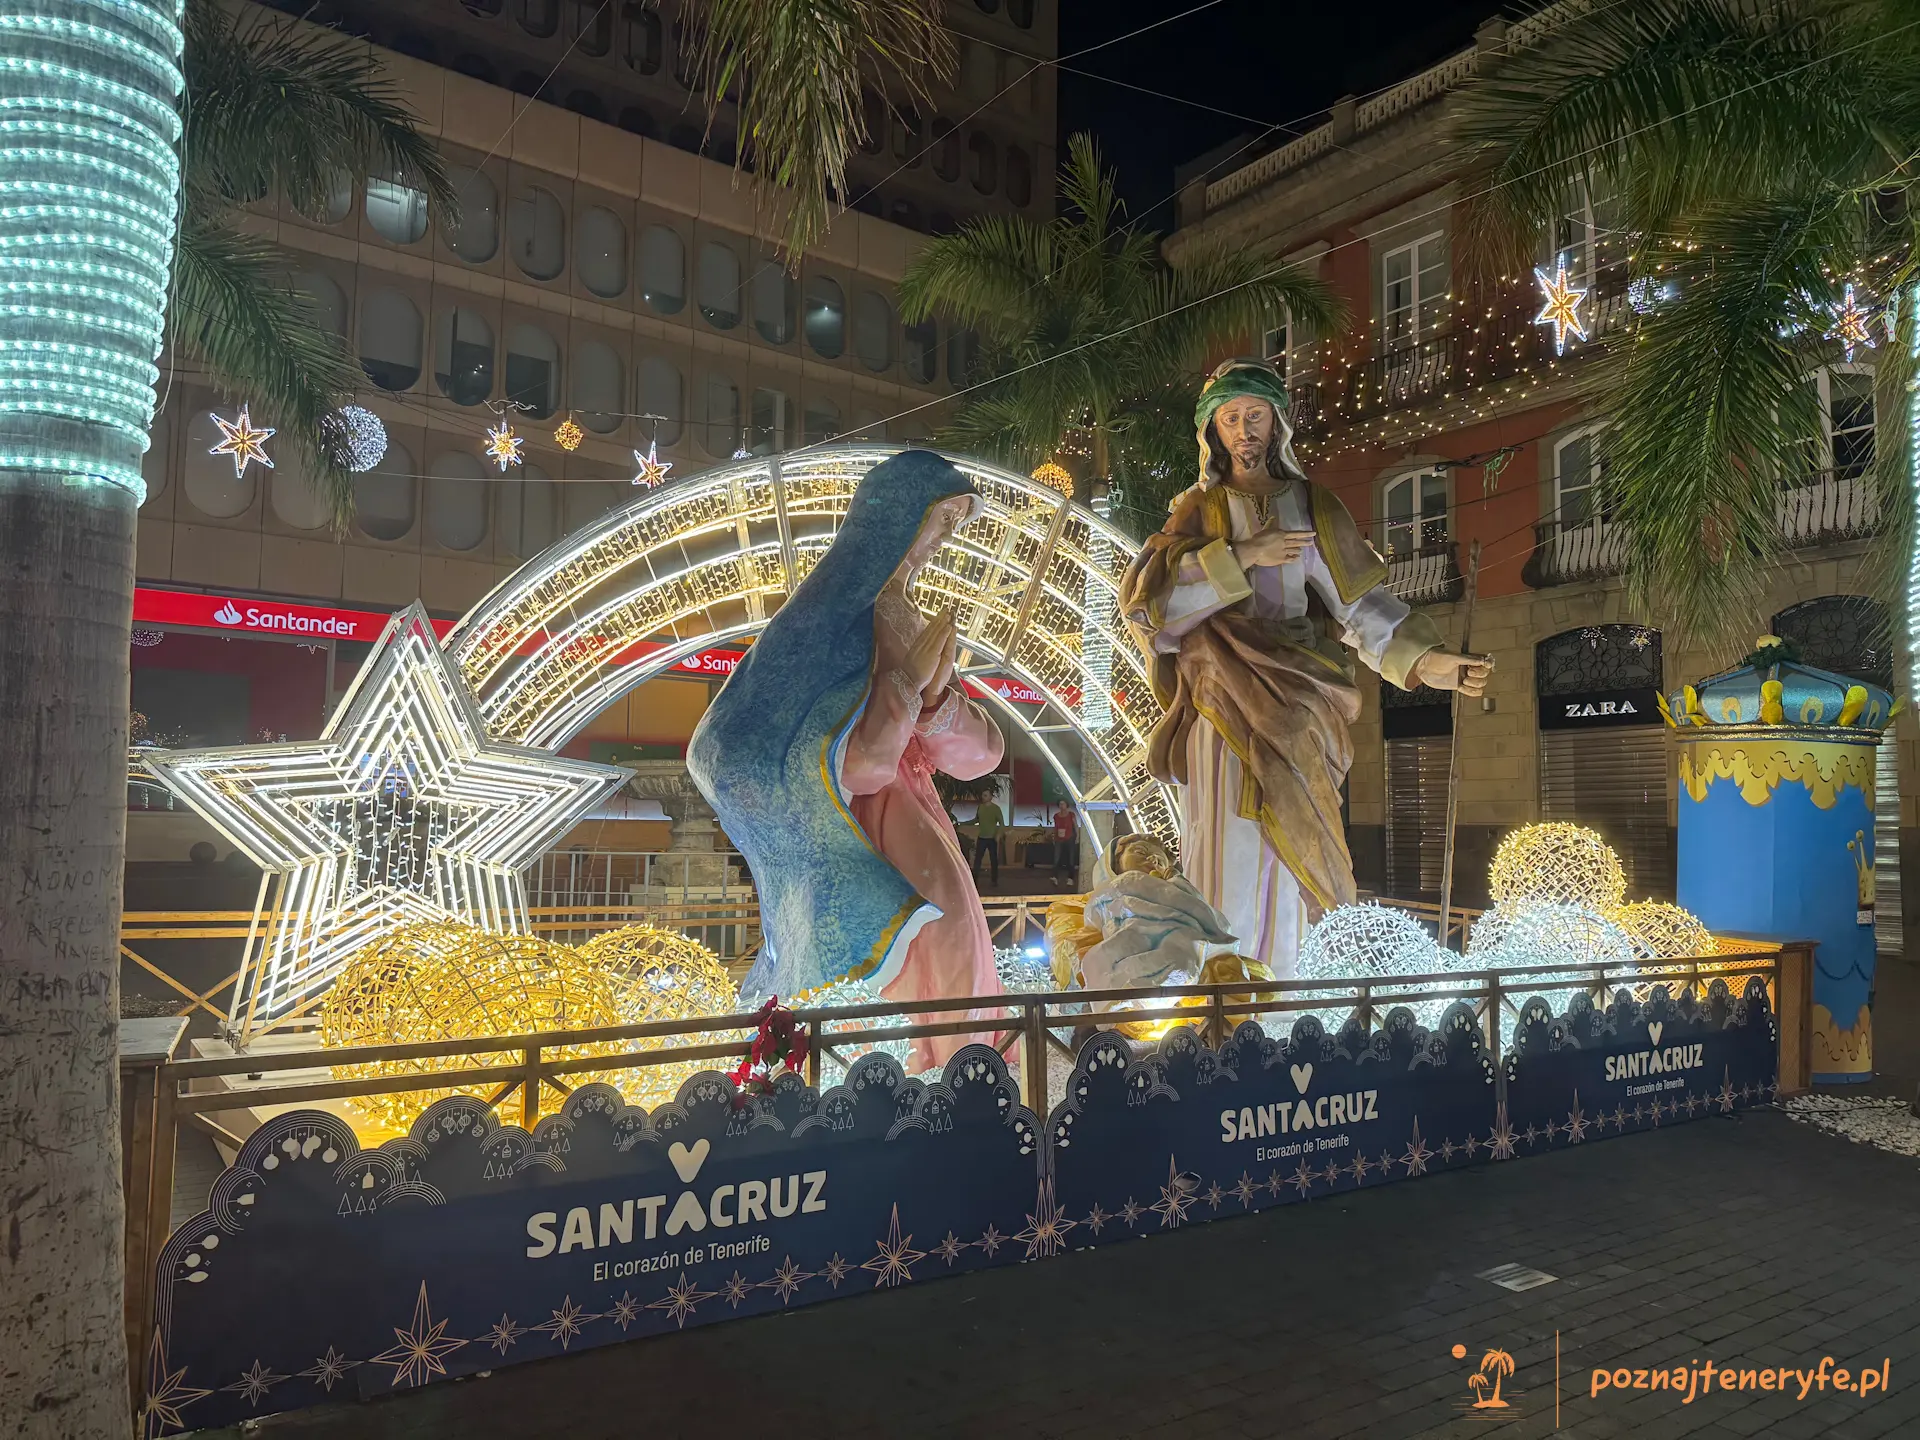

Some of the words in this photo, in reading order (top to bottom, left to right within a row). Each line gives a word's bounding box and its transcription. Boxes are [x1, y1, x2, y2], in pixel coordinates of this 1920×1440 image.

[245, 608, 358, 636] Santander
[1564, 700, 1638, 718] ZARA
[1626, 1085, 1633, 1097] El
[1633, 1081, 1655, 1096] corazón
[1655, 1080, 1663, 1092] de
[1663, 1076, 1685, 1090] Tenerife
[1256, 1147, 1265, 1162] El
[1267, 1141, 1301, 1160] corazón
[1303, 1139, 1314, 1153] de
[1315, 1133, 1350, 1151] Tenerife
[593, 1261, 609, 1282] El
[613, 1251, 680, 1278] corazón
[684, 1246, 704, 1265] de
[708, 1235, 771, 1260] Tenerife
